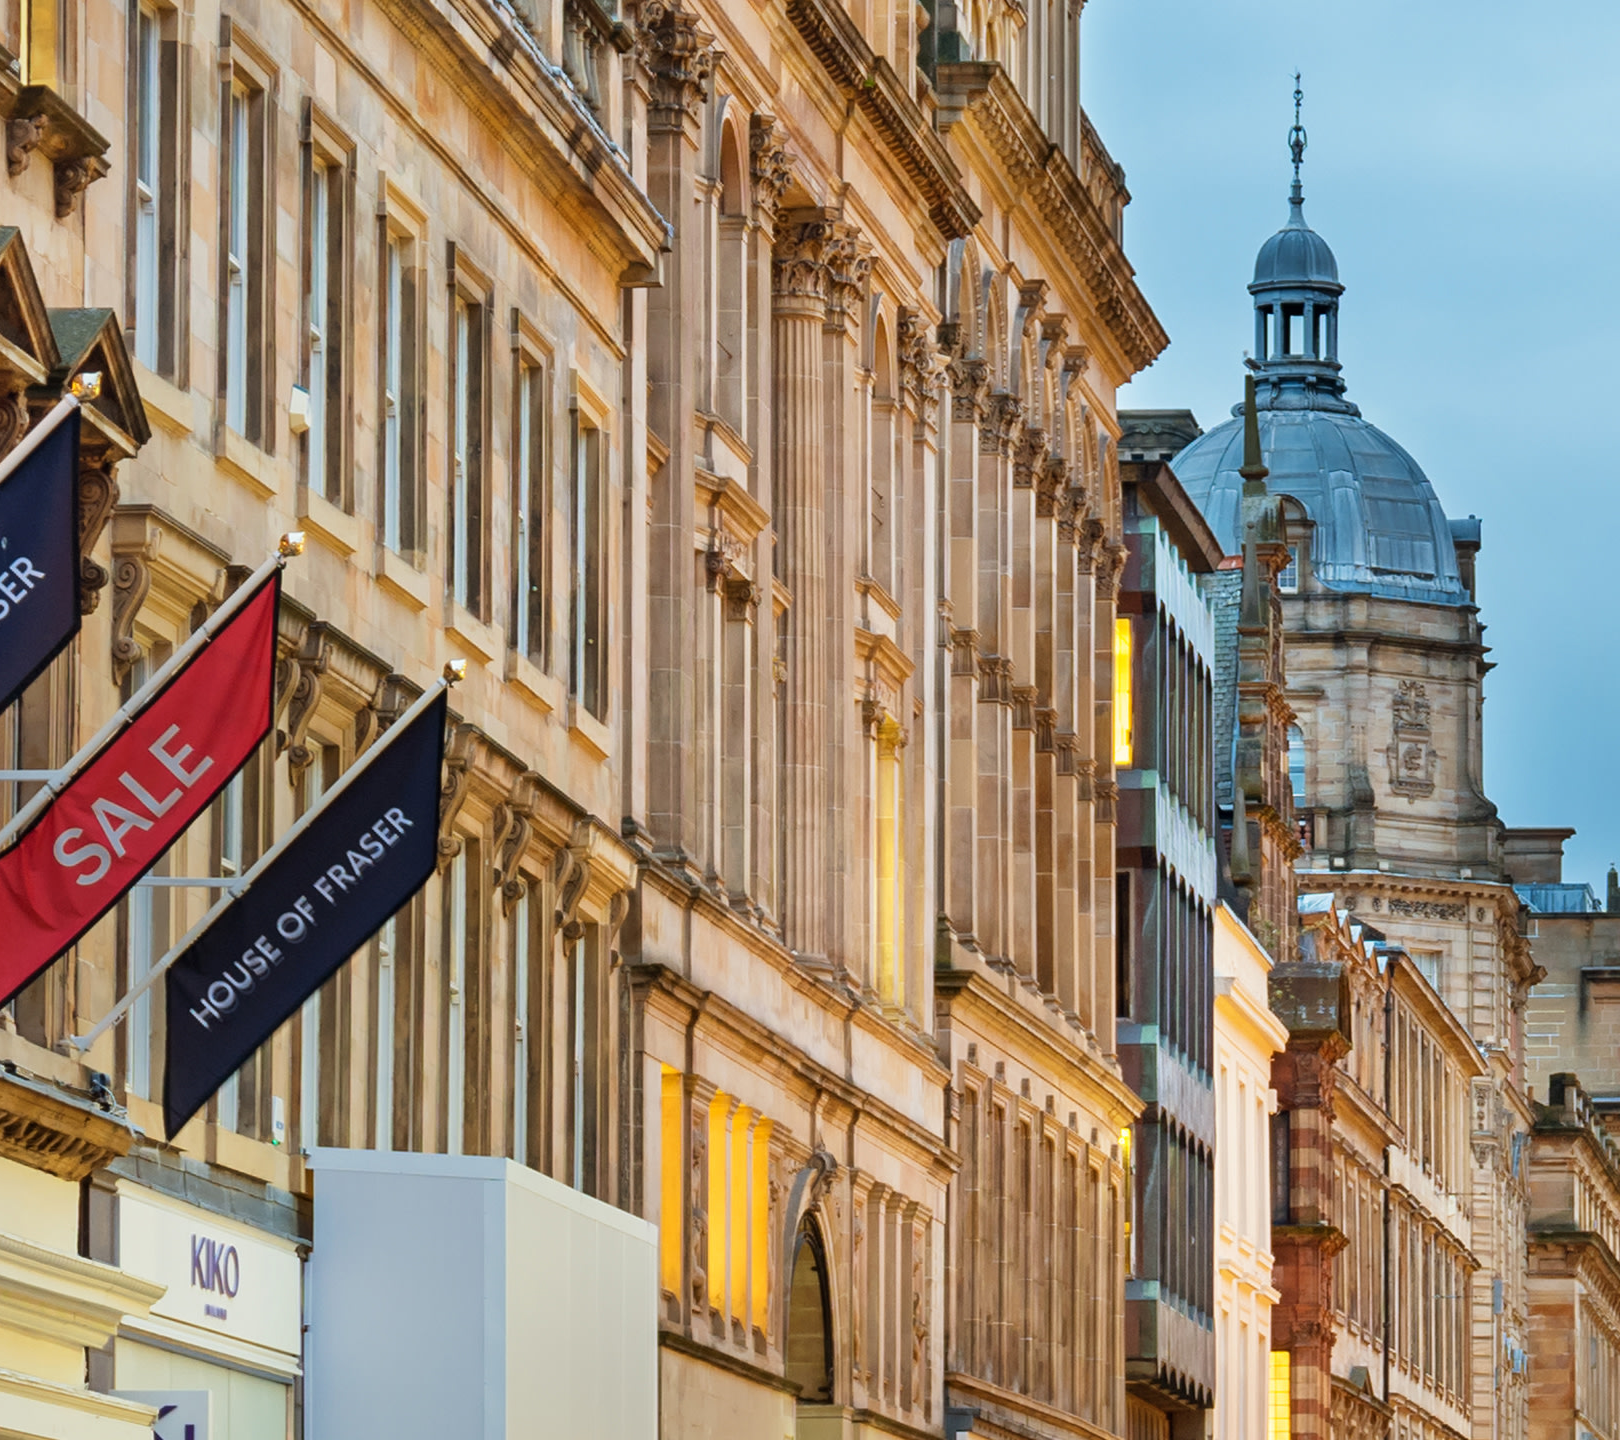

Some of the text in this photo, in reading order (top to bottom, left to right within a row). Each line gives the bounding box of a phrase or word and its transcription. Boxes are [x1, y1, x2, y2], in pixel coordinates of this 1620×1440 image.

[53, 723, 214, 886] SALE
[189, 806, 414, 1029] HOUSE OF FRASER
[191, 1234, 240, 1298] KIKO
